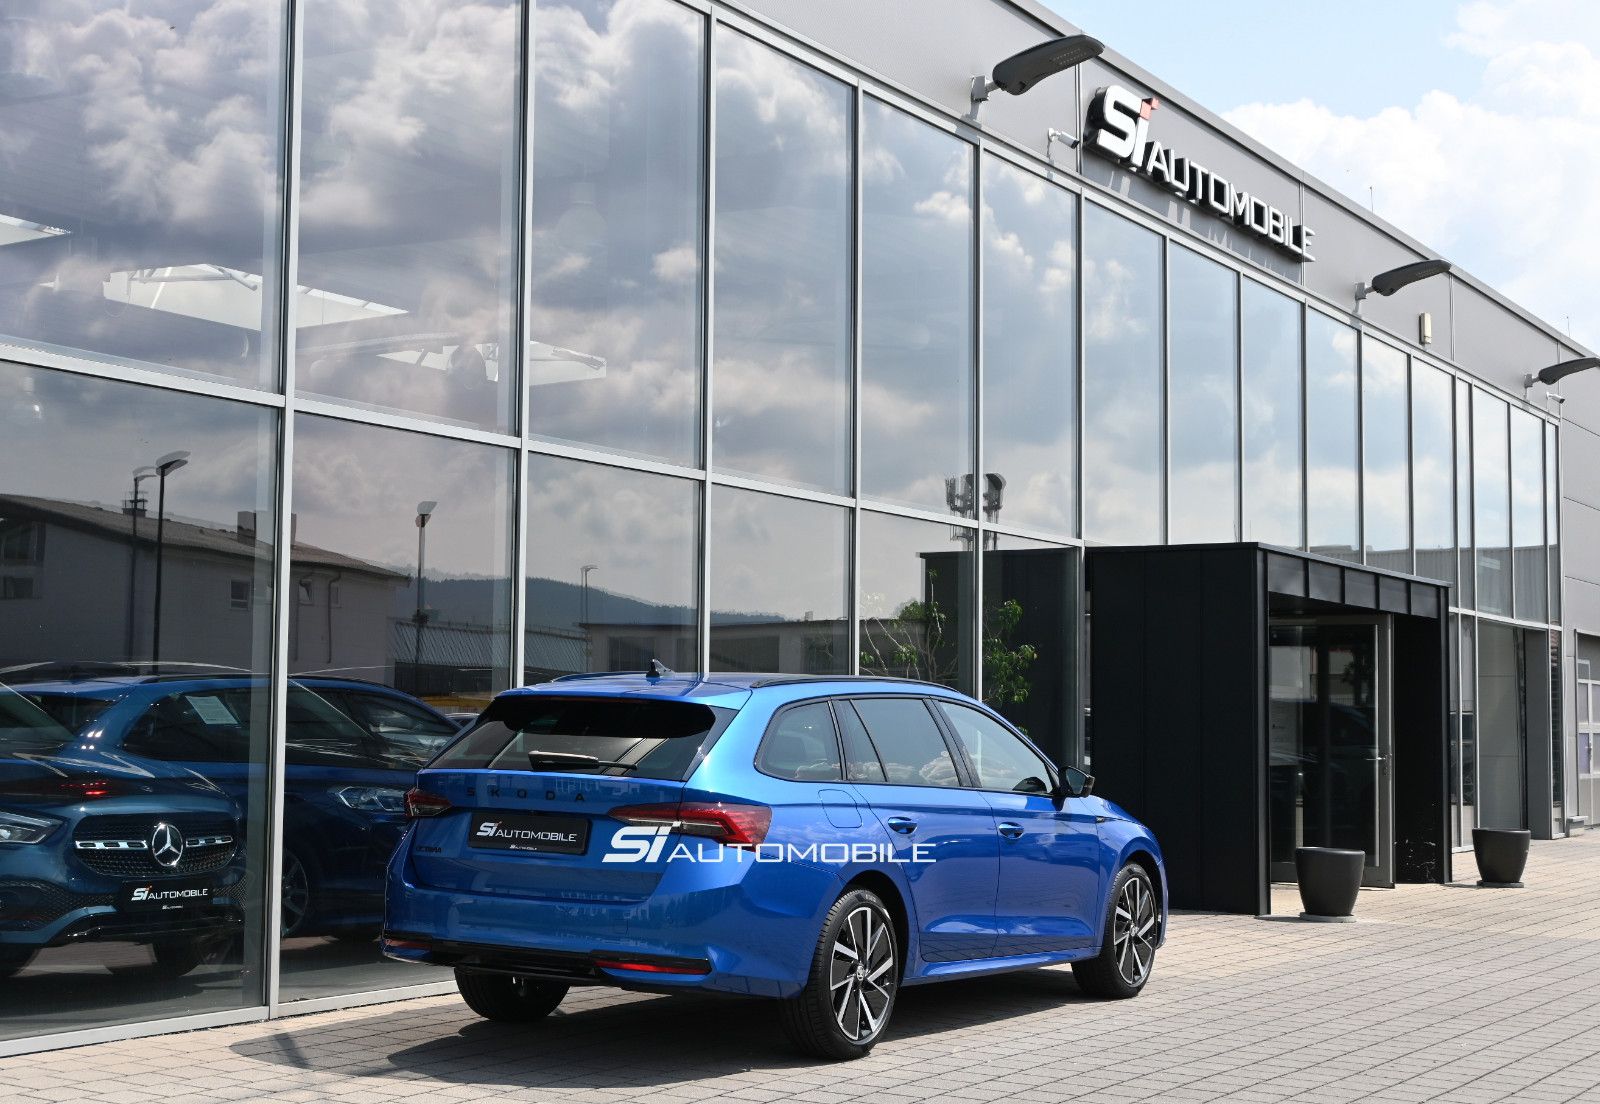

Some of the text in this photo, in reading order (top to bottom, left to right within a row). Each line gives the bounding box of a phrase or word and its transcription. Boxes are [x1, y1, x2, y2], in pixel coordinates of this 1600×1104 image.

[1146, 140, 1316, 263] AUTOMOBILE
[495, 829, 578, 842] AUTOMOBILE
[147, 888, 208, 900] AUTOMOBILE
